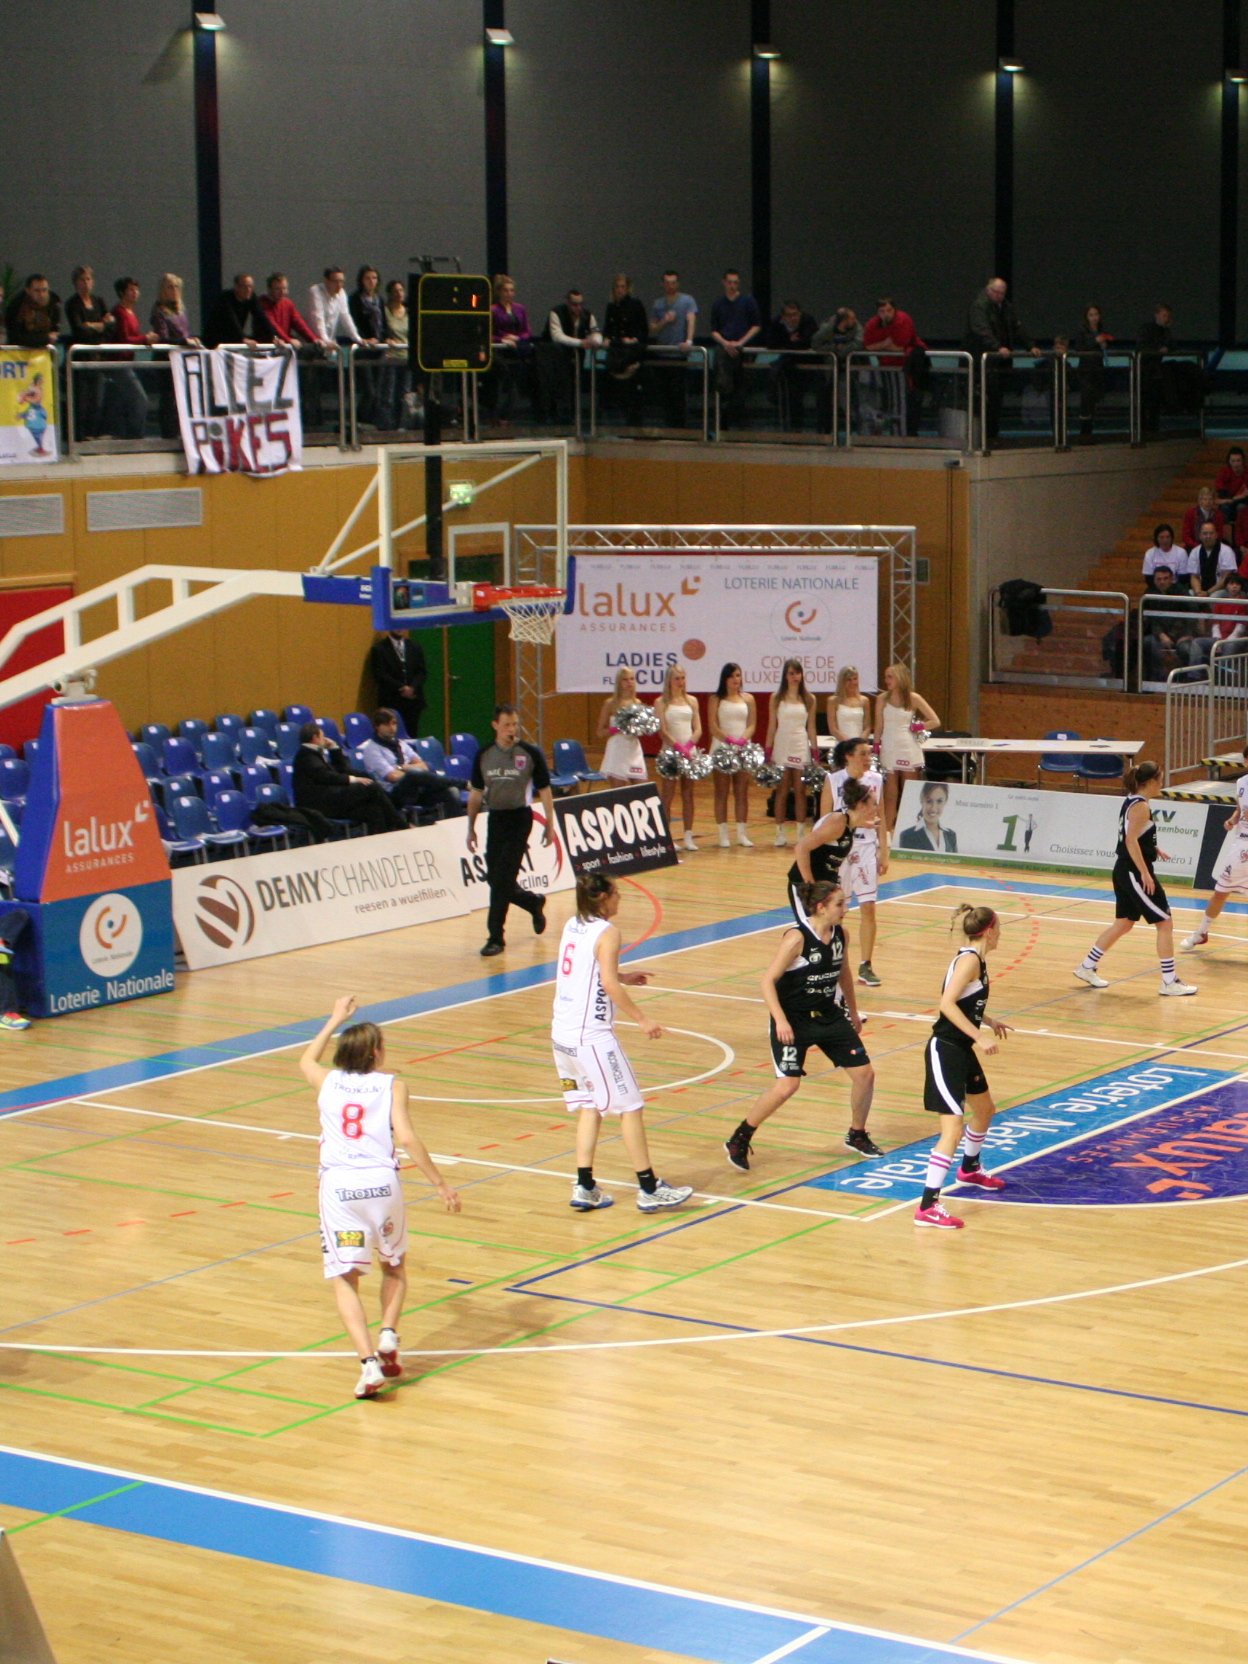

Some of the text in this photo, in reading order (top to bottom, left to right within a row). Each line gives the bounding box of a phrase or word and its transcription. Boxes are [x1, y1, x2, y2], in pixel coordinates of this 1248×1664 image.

[0, 361, 28, 379] RT
[724, 577, 860, 590] LOTERIE NATIONALE
[578, 582, 676, 618] lalux
[580, 622, 677, 632] ASSURANCES
[605, 652, 678, 667] LADIES
[815, 655, 835, 669] DE
[744, 671, 836, 684] LUXEOUR
[1151, 809, 1176, 822] KV
[564, 796, 667, 857] ASPORT
[997, 814, 1019, 851] 1
[1156, 825, 1199, 837] xembourg
[63, 816, 134, 857] lalux
[582, 857, 601, 871] sport
[607, 850, 634, 865] fashion
[1050, 843, 1094, 857] Choisissez
[1096, 849, 1117, 859] vous
[65, 852, 135, 874] ASSURANCES
[255, 849, 441, 912] DEMYSCHANDELER
[520, 874, 549, 889] cling
[354, 899, 389, 914] reesen
[391, 898, 397, 907] a
[561, 943, 576, 976] 6
[831, 942, 843, 961] 12
[50, 968, 174, 1014] Loterie Nationale
[594, 972, 607, 1022] ASPO
[782, 1045, 798, 1062] 12
[1048, 1066, 1209, 1114] Loterie
[342, 1103, 364, 1140] 8
